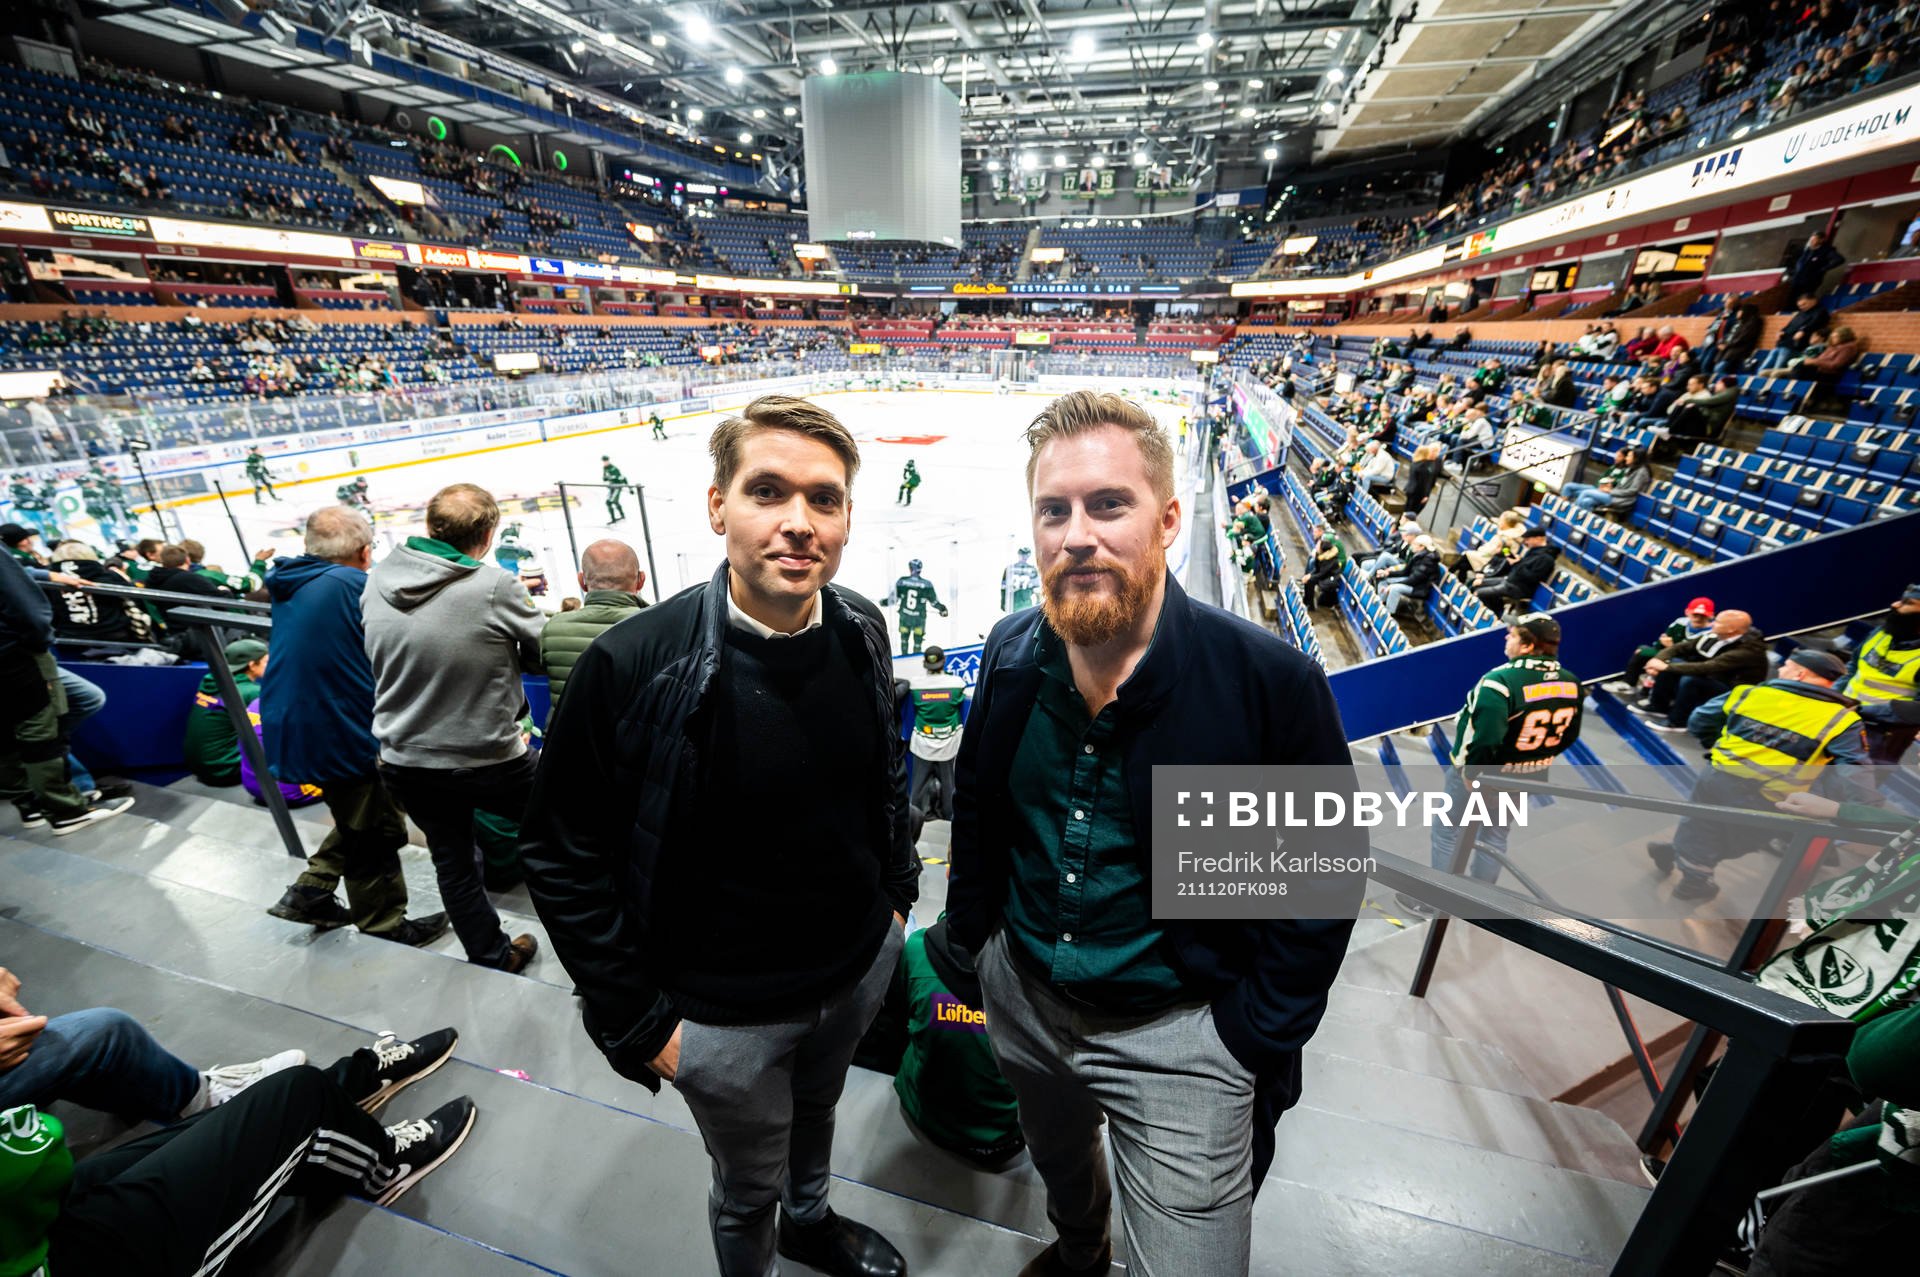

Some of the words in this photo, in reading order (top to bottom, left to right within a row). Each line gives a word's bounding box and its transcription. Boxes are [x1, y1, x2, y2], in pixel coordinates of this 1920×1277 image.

[1809, 105, 1912, 150] UDDEHOLM
[1064, 176, 1076, 190] 17
[1101, 174, 1113, 189] 19
[1012, 284, 1087, 293] RESTAURANG
[1093, 284, 1101, 292] &
[1107, 284, 1131, 293] BAR
[906, 589, 918, 611] 6
[1515, 706, 1577, 752] 63
